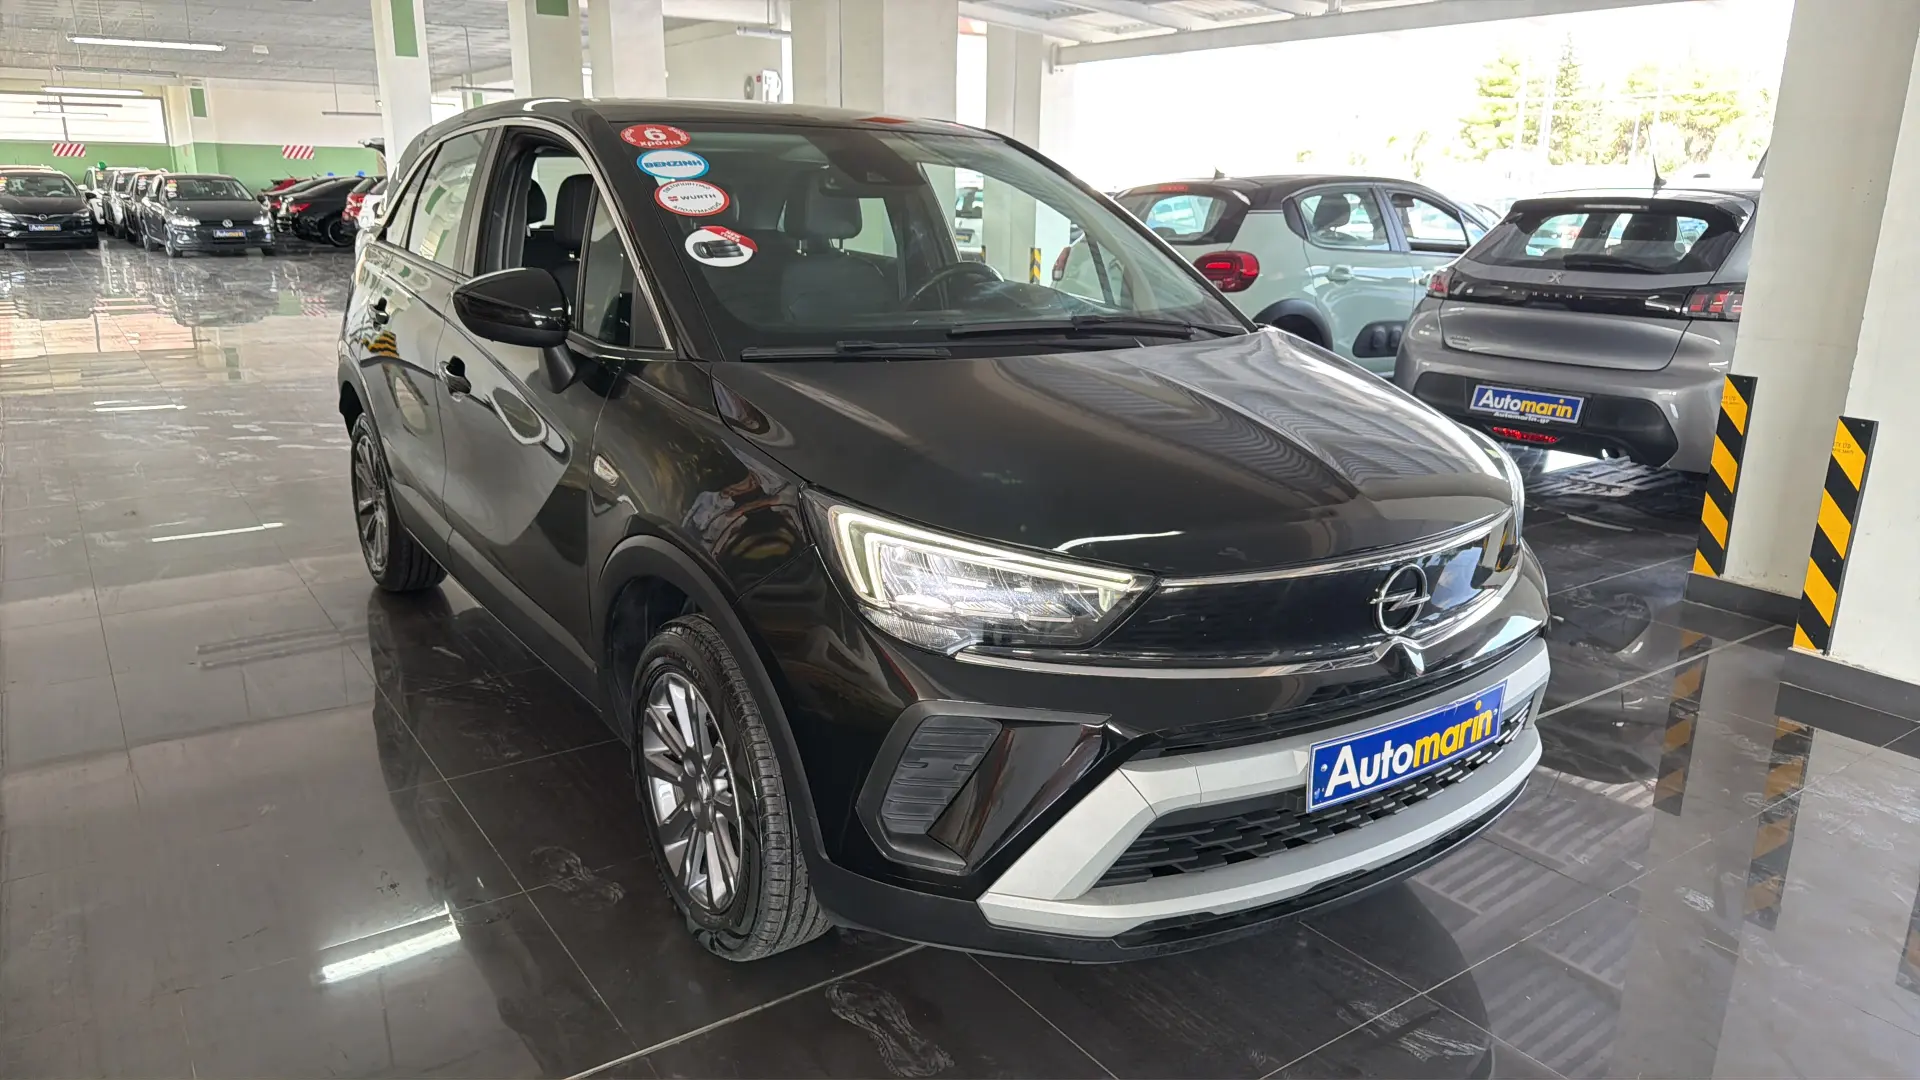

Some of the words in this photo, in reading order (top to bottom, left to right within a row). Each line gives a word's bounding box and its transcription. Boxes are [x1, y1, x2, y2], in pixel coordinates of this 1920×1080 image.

[643, 128, 667, 141] 6
[1477, 389, 1573, 418] Automarin
[1324, 699, 1493, 797] Automarin
